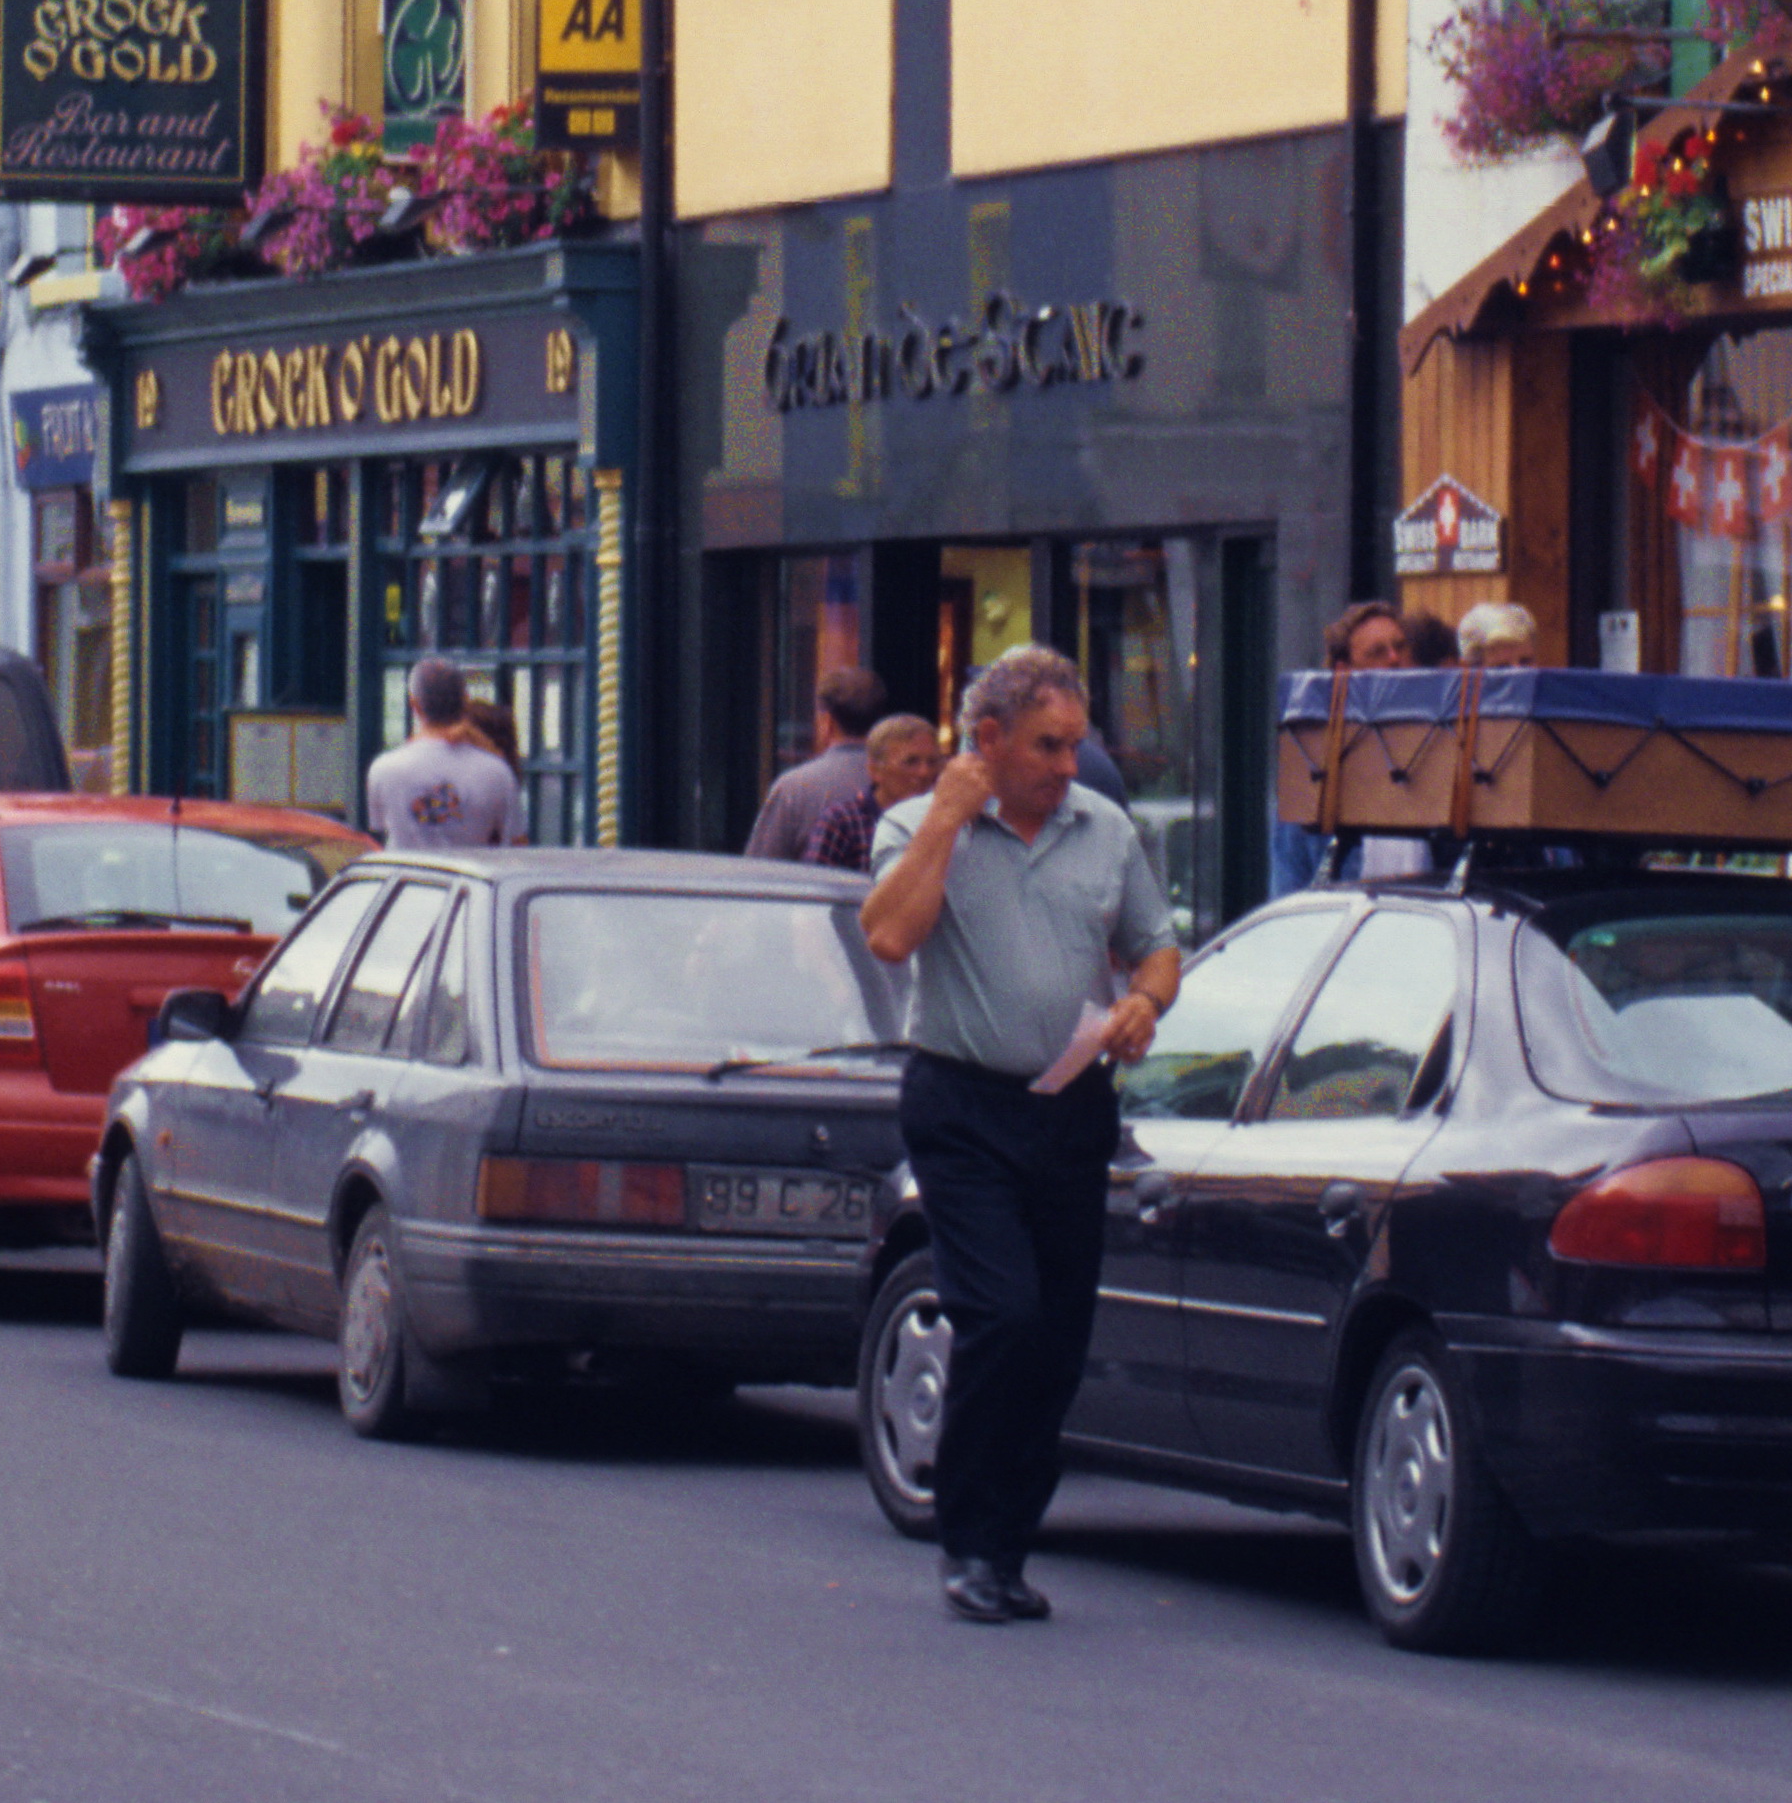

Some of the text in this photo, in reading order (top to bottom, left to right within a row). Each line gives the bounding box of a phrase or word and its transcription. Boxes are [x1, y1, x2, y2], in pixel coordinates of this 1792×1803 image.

[54, 91, 220, 137] Bar and
[3, 123, 233, 171] Restaurant
